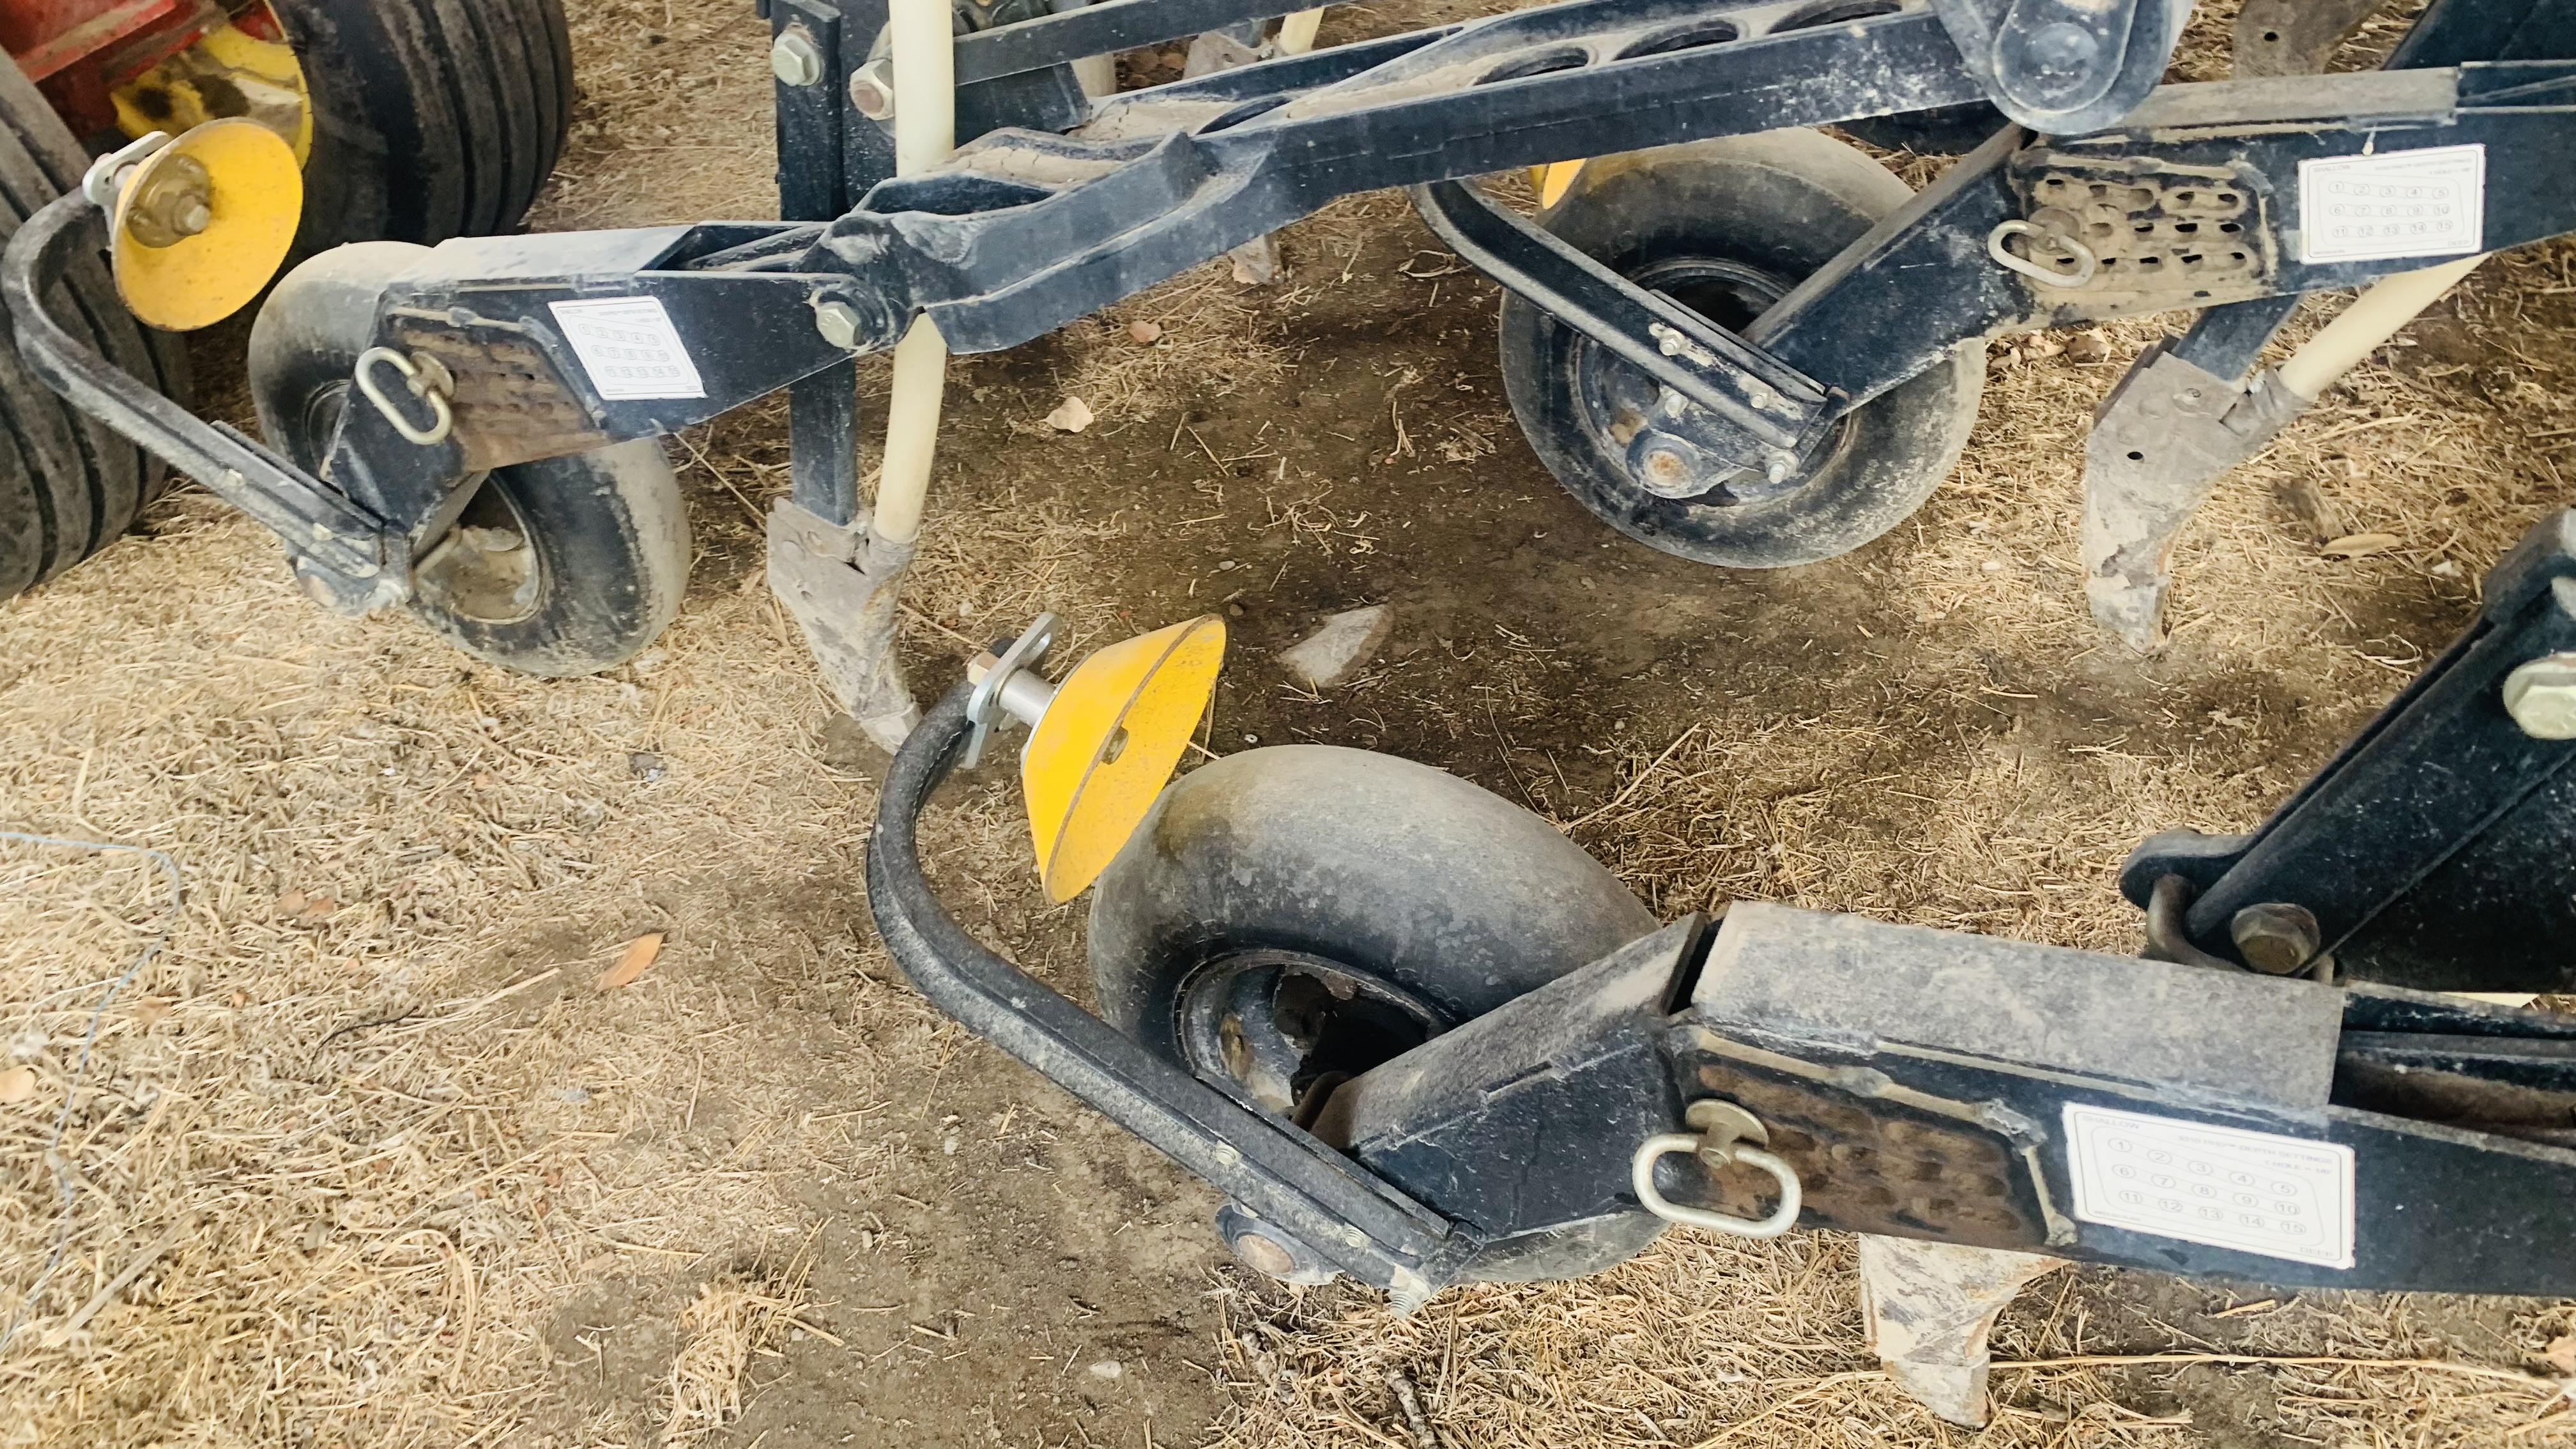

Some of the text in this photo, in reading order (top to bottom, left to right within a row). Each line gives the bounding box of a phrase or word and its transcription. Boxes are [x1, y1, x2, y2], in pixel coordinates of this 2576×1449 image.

[2436, 206, 2449, 215] 10
[2361, 227, 2373, 236] 12
[2386, 226, 2398, 234] 13
[2413, 224, 2425, 232] 14
[2439, 222, 2451, 230] 15
[2082, 1116, 2140, 1130] SHALLOW
[2278, 1150, 2333, 1164] SETTINGS
[2155, 1152, 2165, 1162] 2
[2196, 1163, 2206, 1172] 3
[2237, 1174, 2247, 1183] 4
[2280, 1184, 2290, 1194] 5
[2120, 1167, 2297, 1215] 6 7 8 9 10
[2124, 1192, 2303, 1233] 11 12 13 14 15
